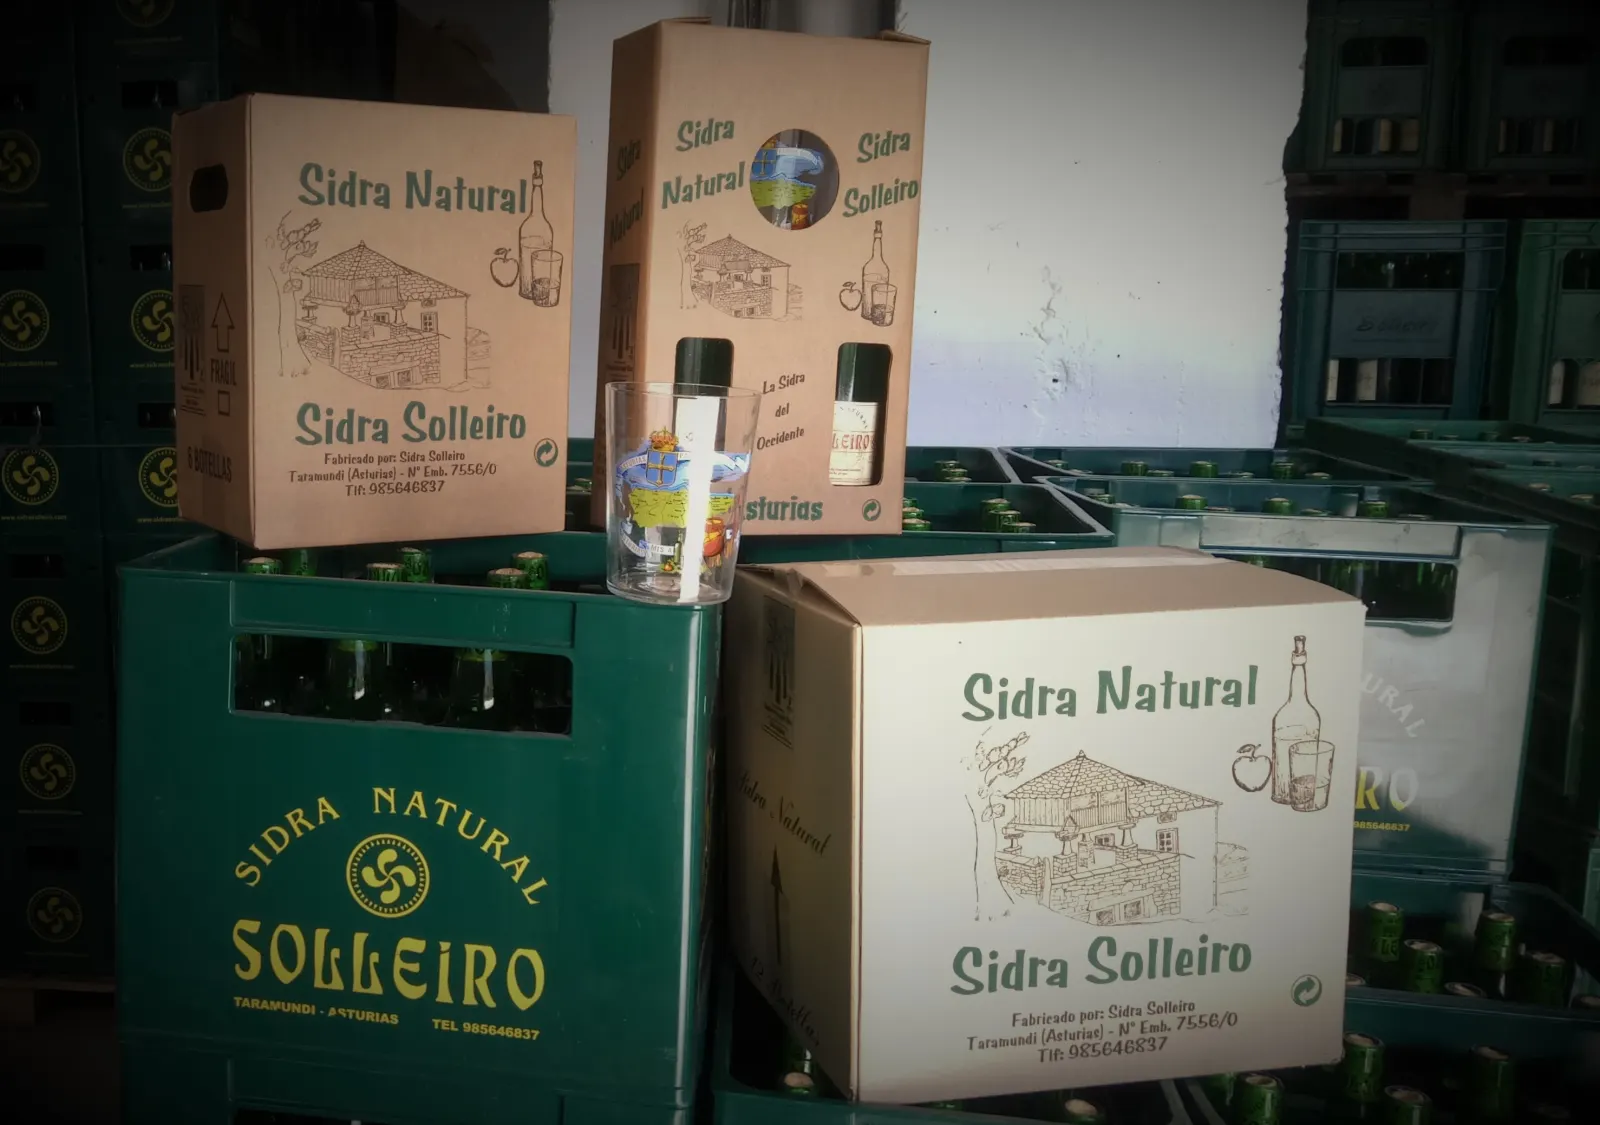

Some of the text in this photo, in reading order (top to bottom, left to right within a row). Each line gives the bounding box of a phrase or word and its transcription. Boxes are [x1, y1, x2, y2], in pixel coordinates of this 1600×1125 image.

[676, 118, 735, 152] Sidra
[856, 129, 911, 164] Sidra
[298, 162, 528, 214] Sidra Natural
[661, 161, 746, 209] Natural
[842, 177, 919, 218] Solleiro
[762, 371, 806, 395] La Sidra
[294, 400, 526, 446] Sidra Solleiro
[774, 402, 790, 418] del
[756, 426, 805, 451] Occidente
[194, 447, 233, 484] BOTELLAS
[289, 470, 345, 483] Taramundi
[347, 467, 397, 481] (Asturias)
[423, 465, 448, 477] Emb.
[450, 462, 498, 476] 7556/0
[324, 450, 466, 467] Fabricado por: Sidra Solleiro
[368, 480, 446, 495] 985646837
[743, 496, 824, 522] sturias
[961, 664, 1259, 723] Sidra Natural
[234, 787, 548, 906] SIDRA NATURAL
[232, 919, 546, 1011] SOLLEIRO
[950, 933, 1252, 995] Sidra Solleiro
[233, 996, 316, 1016] TARAMUNDI
[327, 1007, 400, 1025] ASTURIAS
[1011, 1000, 1196, 1028] Fabricado por: Sidra Solleiro
[432, 1018, 540, 1041] TEL 985646837
[967, 1032, 1037, 1051] Taramundi
[1041, 1025, 1105, 1045] (Asturias)
[1139, 1019, 1172, 1034] Emb.
[1176, 1011, 1238, 1031] 7556/0
[1068, 1035, 1169, 1060] 985646837
